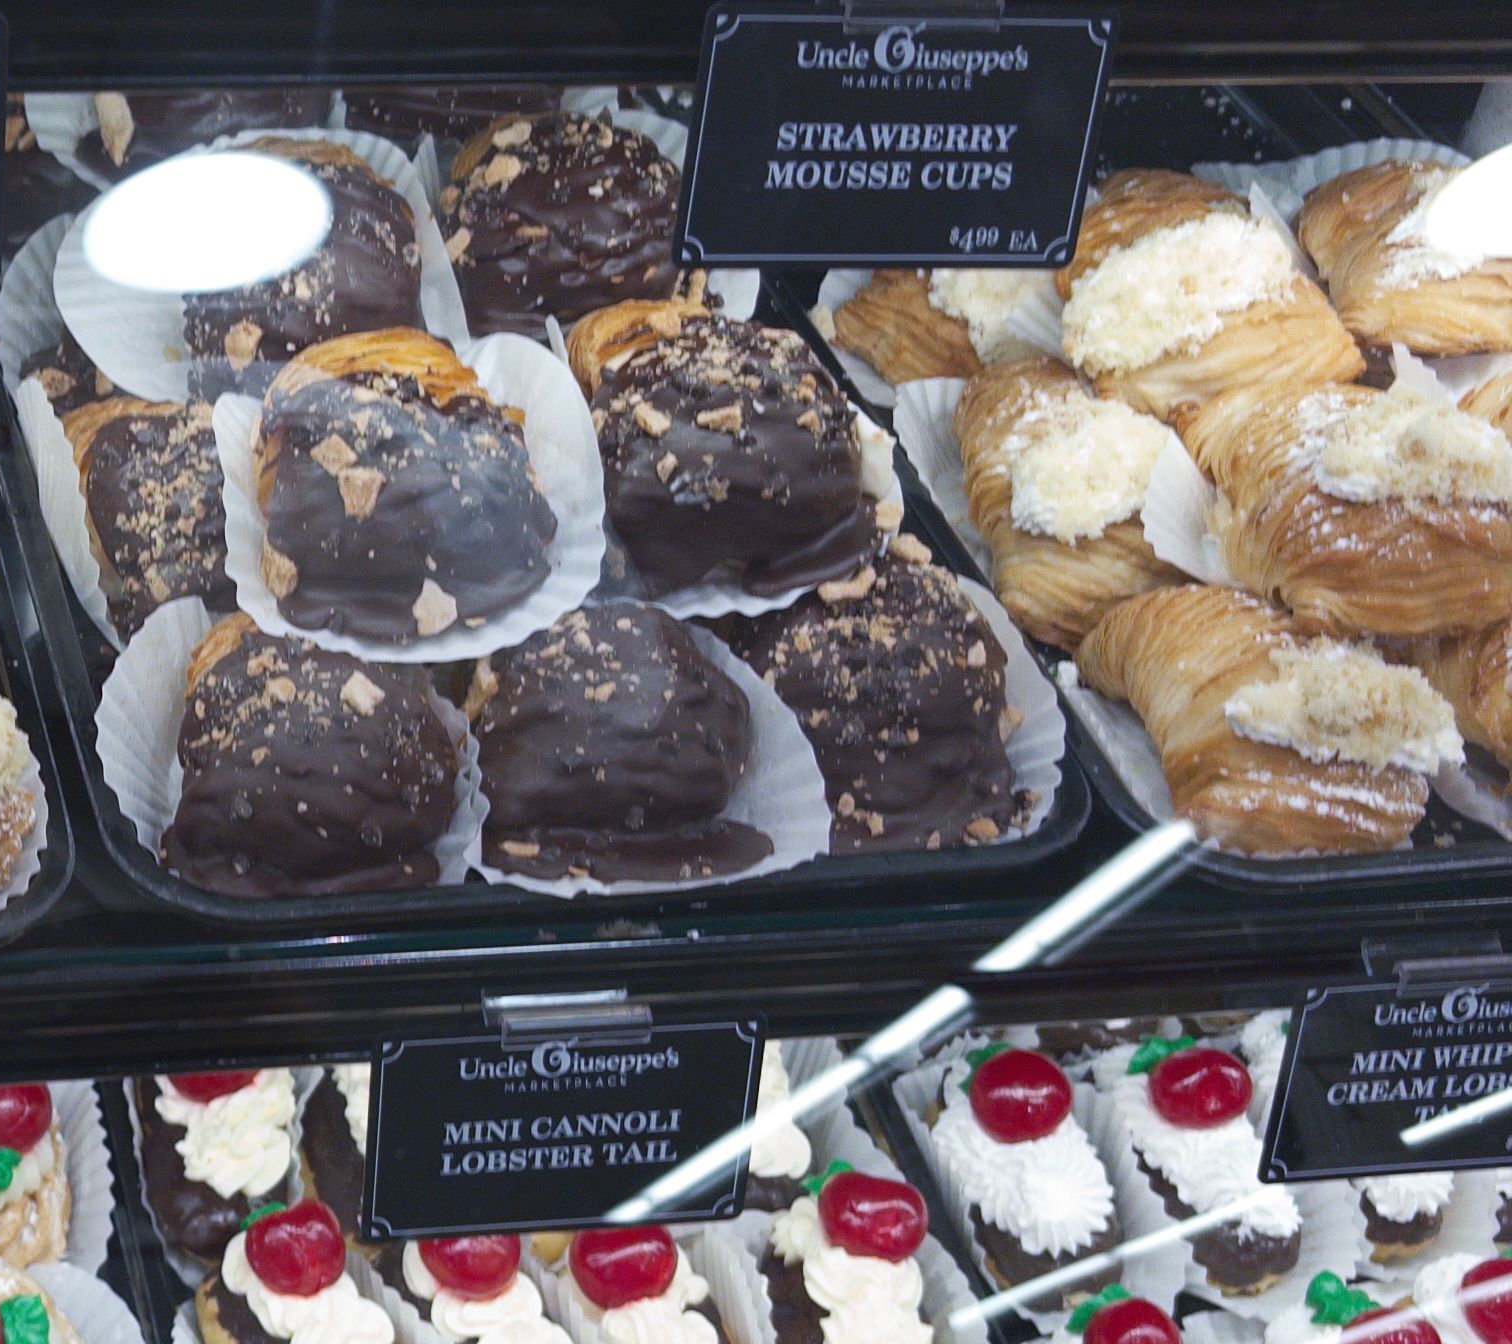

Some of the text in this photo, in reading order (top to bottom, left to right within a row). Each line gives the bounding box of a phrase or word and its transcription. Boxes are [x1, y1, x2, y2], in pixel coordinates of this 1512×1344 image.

[797, 22, 1028, 76] Uncle Giuseppe's
[841, 74, 972, 90] MARKETPLACE
[776, 122, 1018, 152] STRAWBERRY
[763, 161, 1013, 190] MOUSSE CUPS
[1008, 230, 1038, 251] EA
[1374, 982, 1512, 1026] Uncle Gius
[459, 1036, 679, 1081] Uncle Giuseppe's
[1349, 1048, 1426, 1075] MINI
[504, 1074, 628, 1093] MARKETPLACE
[1327, 1075, 1437, 1106] CREAM
[443, 1109, 682, 1146] MINI CANNOLI
[439, 1140, 678, 1176] LOBSTER TAIL
